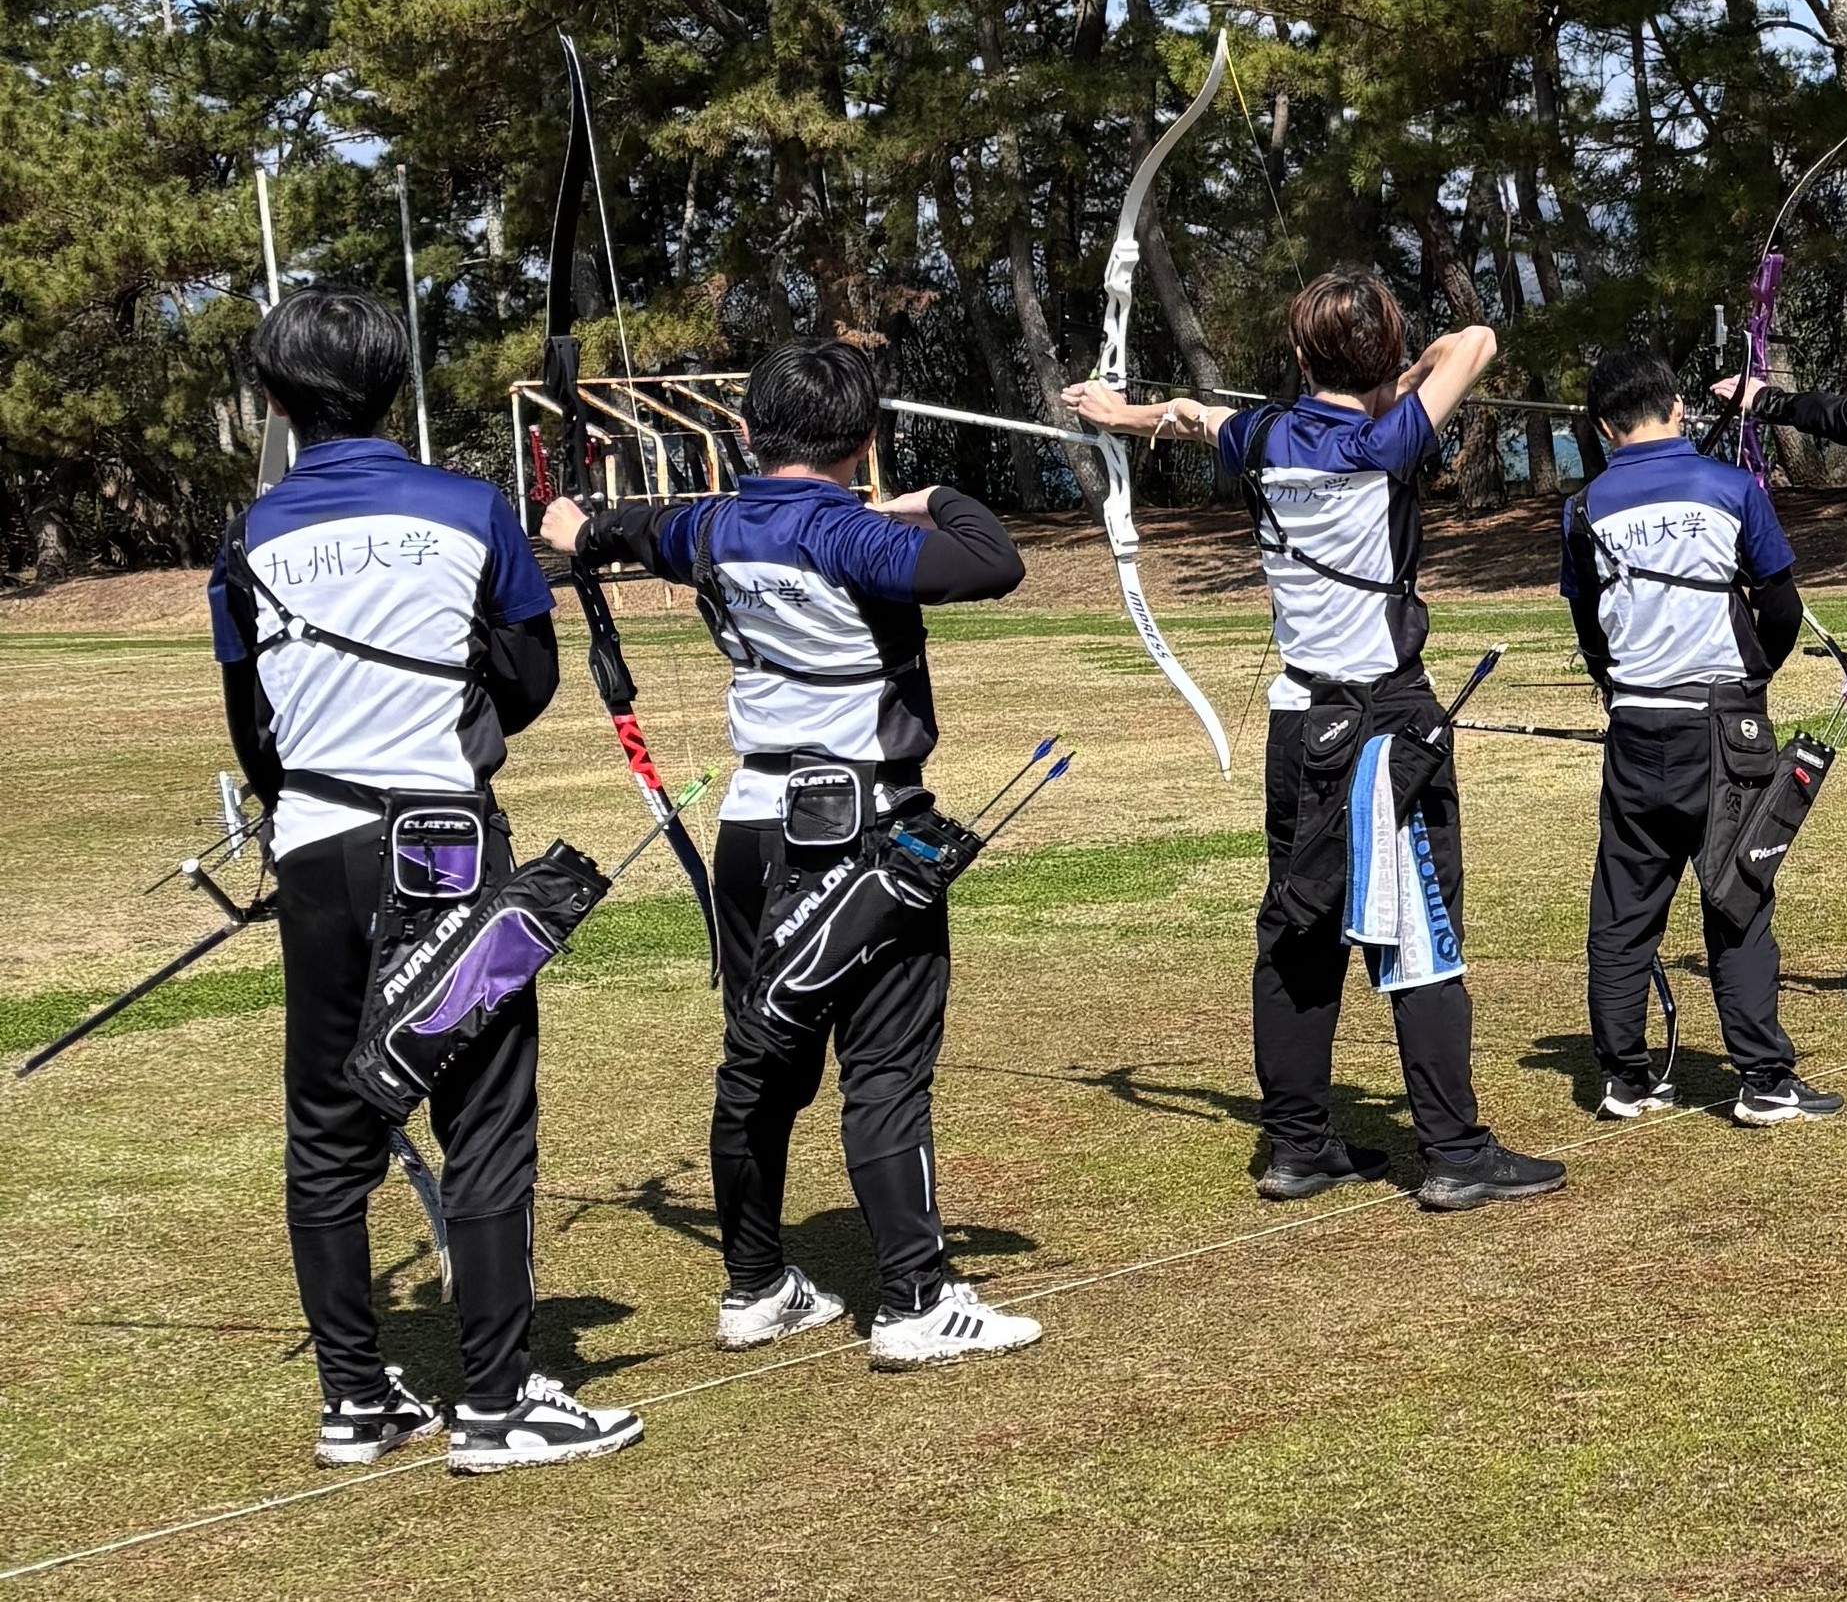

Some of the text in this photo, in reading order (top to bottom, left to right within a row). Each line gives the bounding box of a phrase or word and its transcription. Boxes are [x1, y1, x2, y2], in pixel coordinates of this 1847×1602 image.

[264, 530, 440, 588] 九州大学
[1598, 511, 1707, 552] 九州大学
[1127, 589, 1171, 660] IMPRESS
[403, 820, 472, 830] CLASSIC
[774, 856, 855, 948] AVALON
[382, 903, 471, 1006] AVALON
